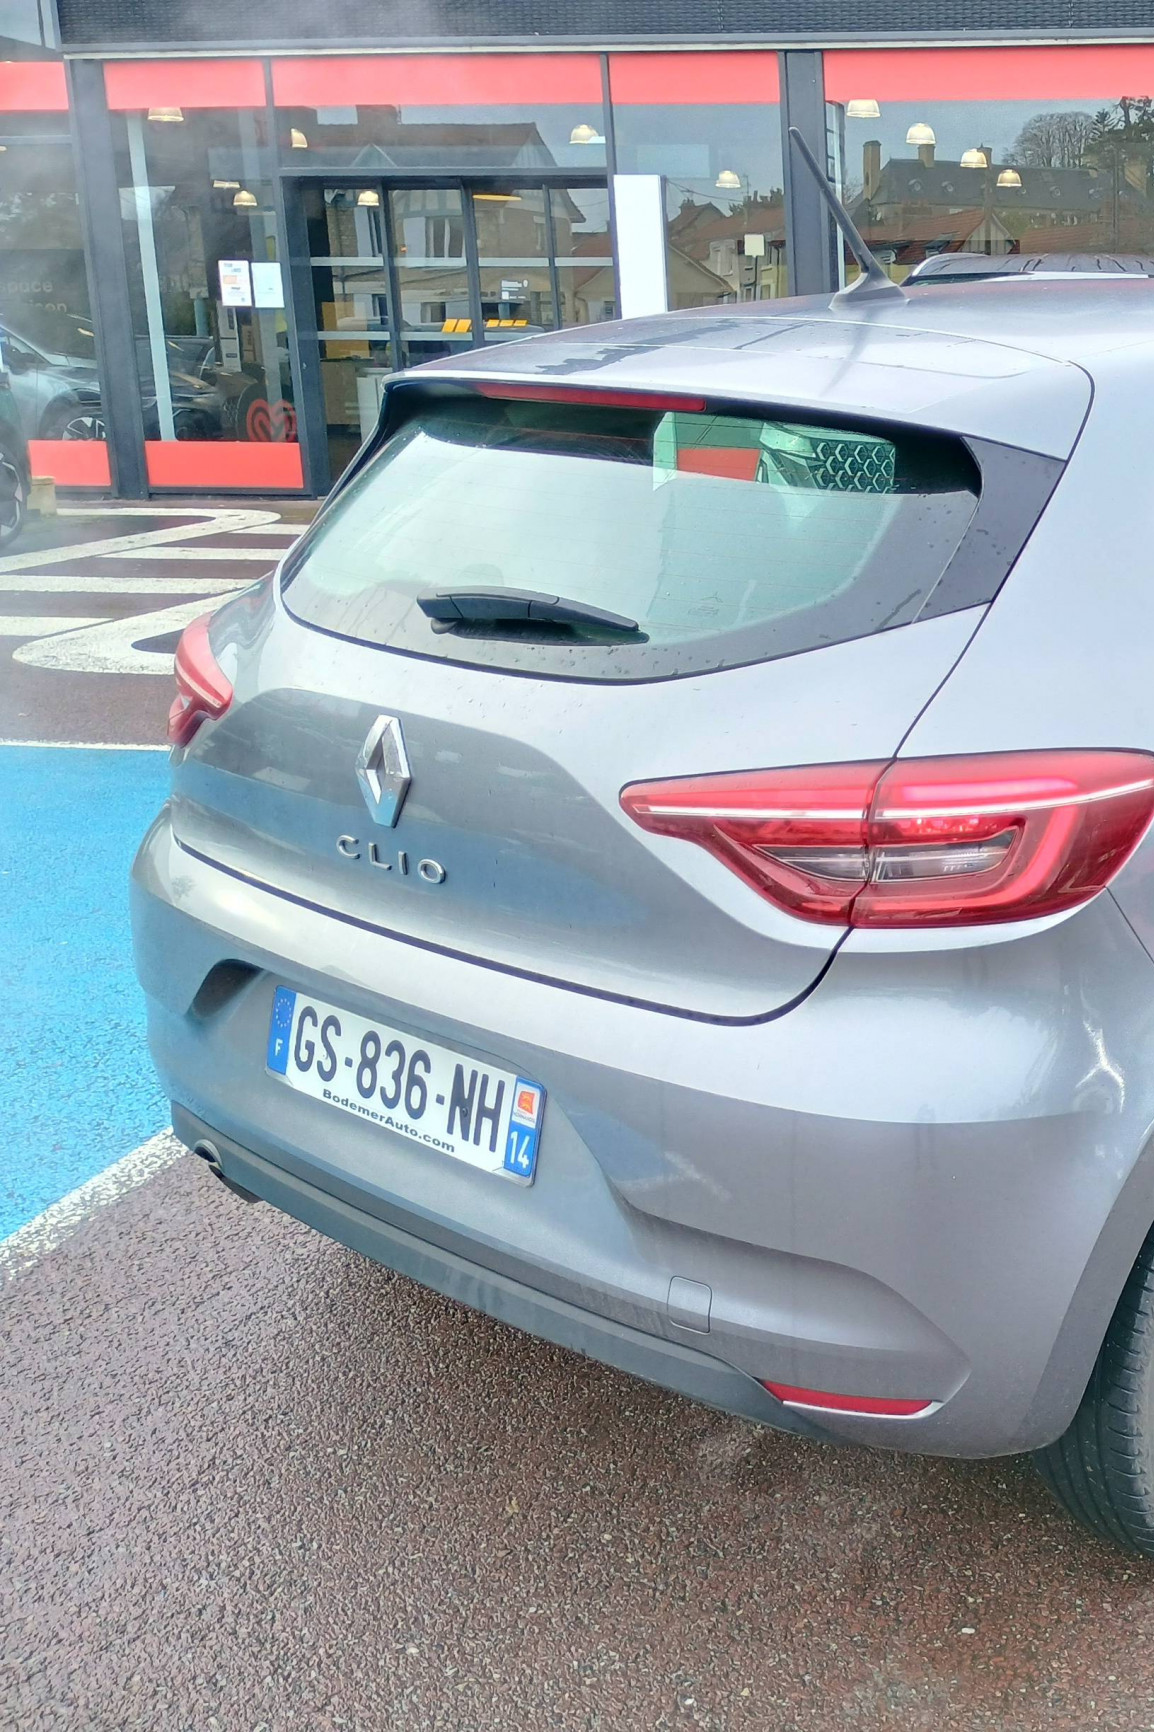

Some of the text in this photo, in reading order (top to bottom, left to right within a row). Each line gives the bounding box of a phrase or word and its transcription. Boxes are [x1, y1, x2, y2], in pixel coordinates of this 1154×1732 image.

[336, 835, 446, 884] CLIO
[274, 1038, 284, 1057] F
[294, 1005, 506, 1153] GS-836-NH
[322, 1088, 456, 1153] BodemerAuto.com
[510, 1131, 531, 1169] 14
